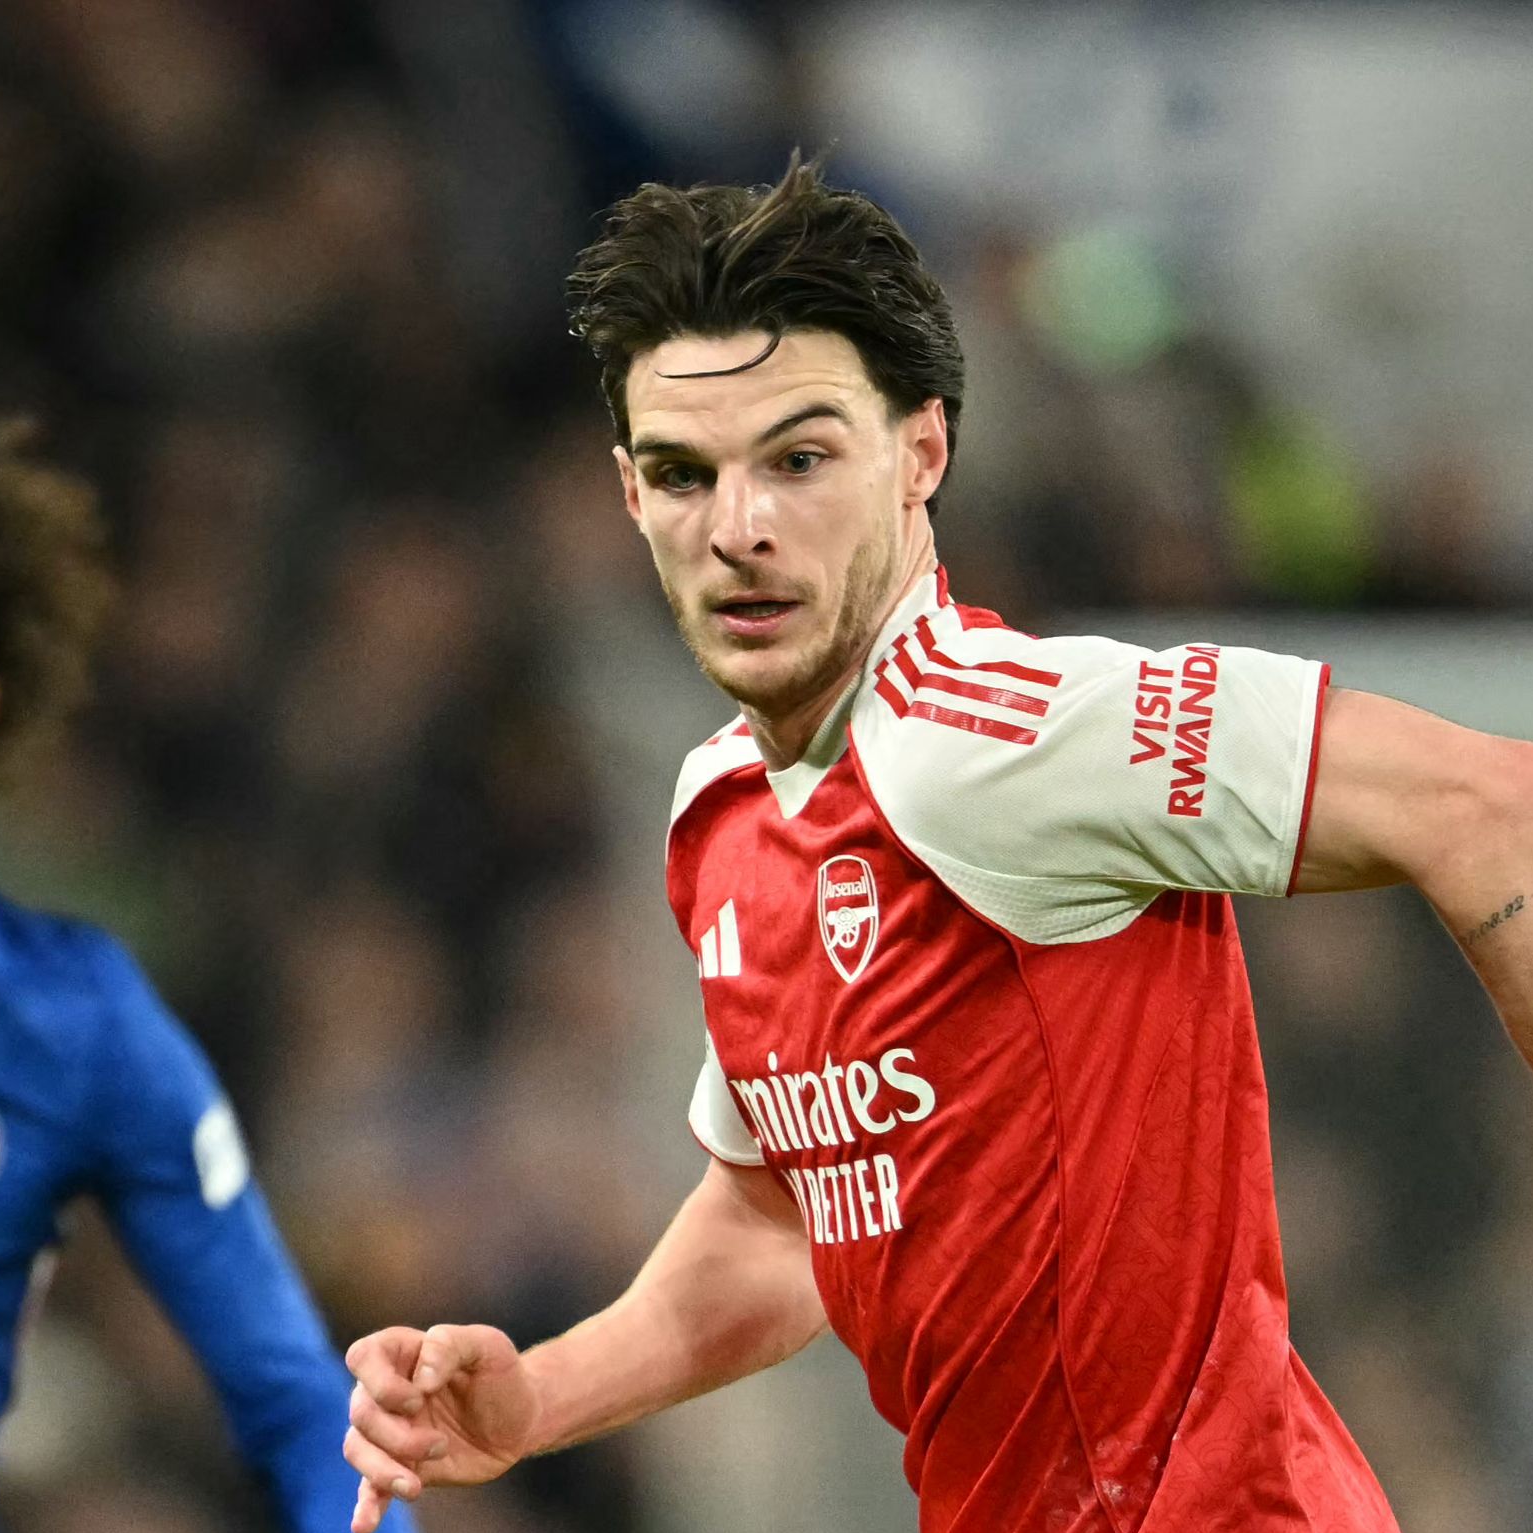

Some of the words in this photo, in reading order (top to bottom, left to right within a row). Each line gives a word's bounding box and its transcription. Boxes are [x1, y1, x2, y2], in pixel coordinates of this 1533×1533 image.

[1129, 661, 1174, 765] VISIT
[1167, 645, 1220, 817] RWANDA
[729, 1047, 936, 1152] mirates
[801, 1153, 903, 1245] BETTER
